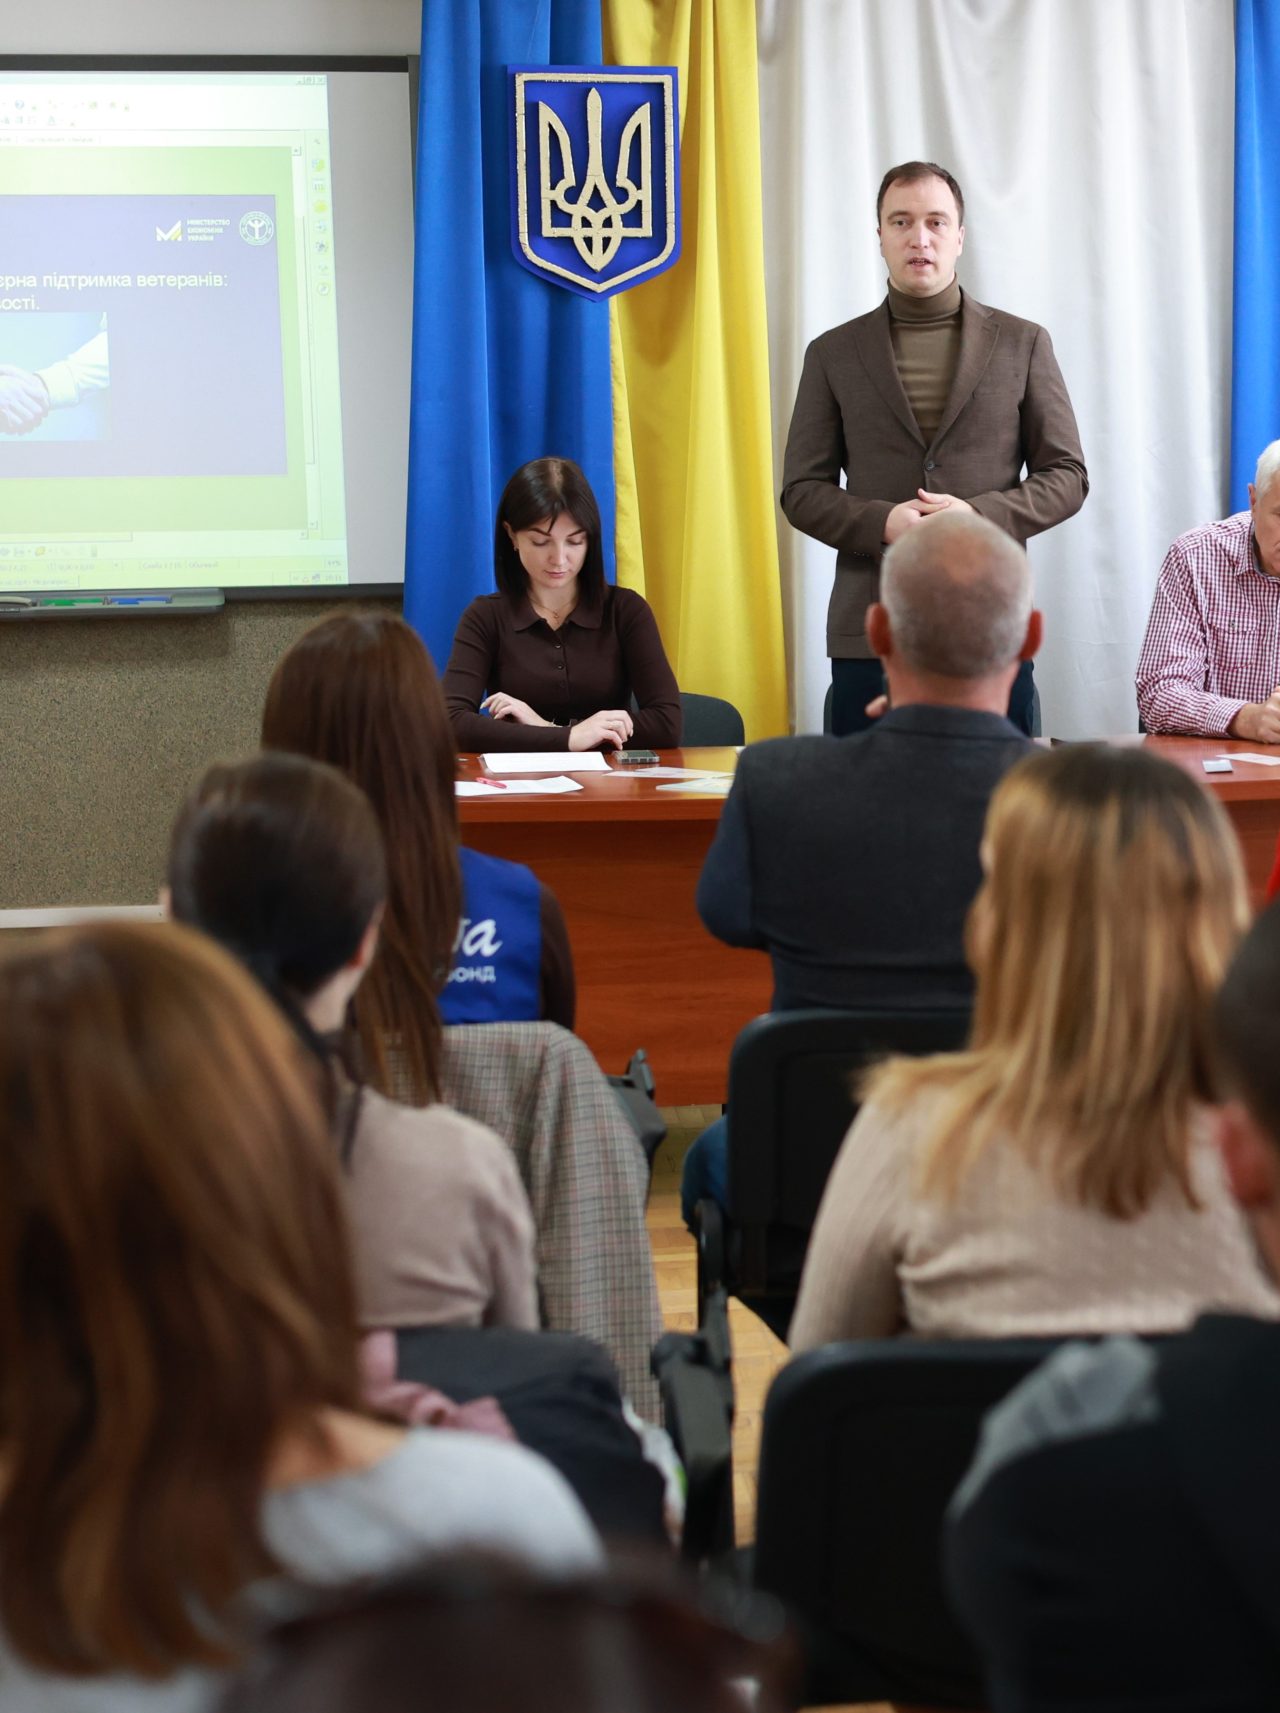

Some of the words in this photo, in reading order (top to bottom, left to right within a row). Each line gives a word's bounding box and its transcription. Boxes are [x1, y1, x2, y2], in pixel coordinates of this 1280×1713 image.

[43, 271, 132, 291] підтримка
[137, 272, 229, 291] ветеранів:
[0, 294, 40, 310] ості.
